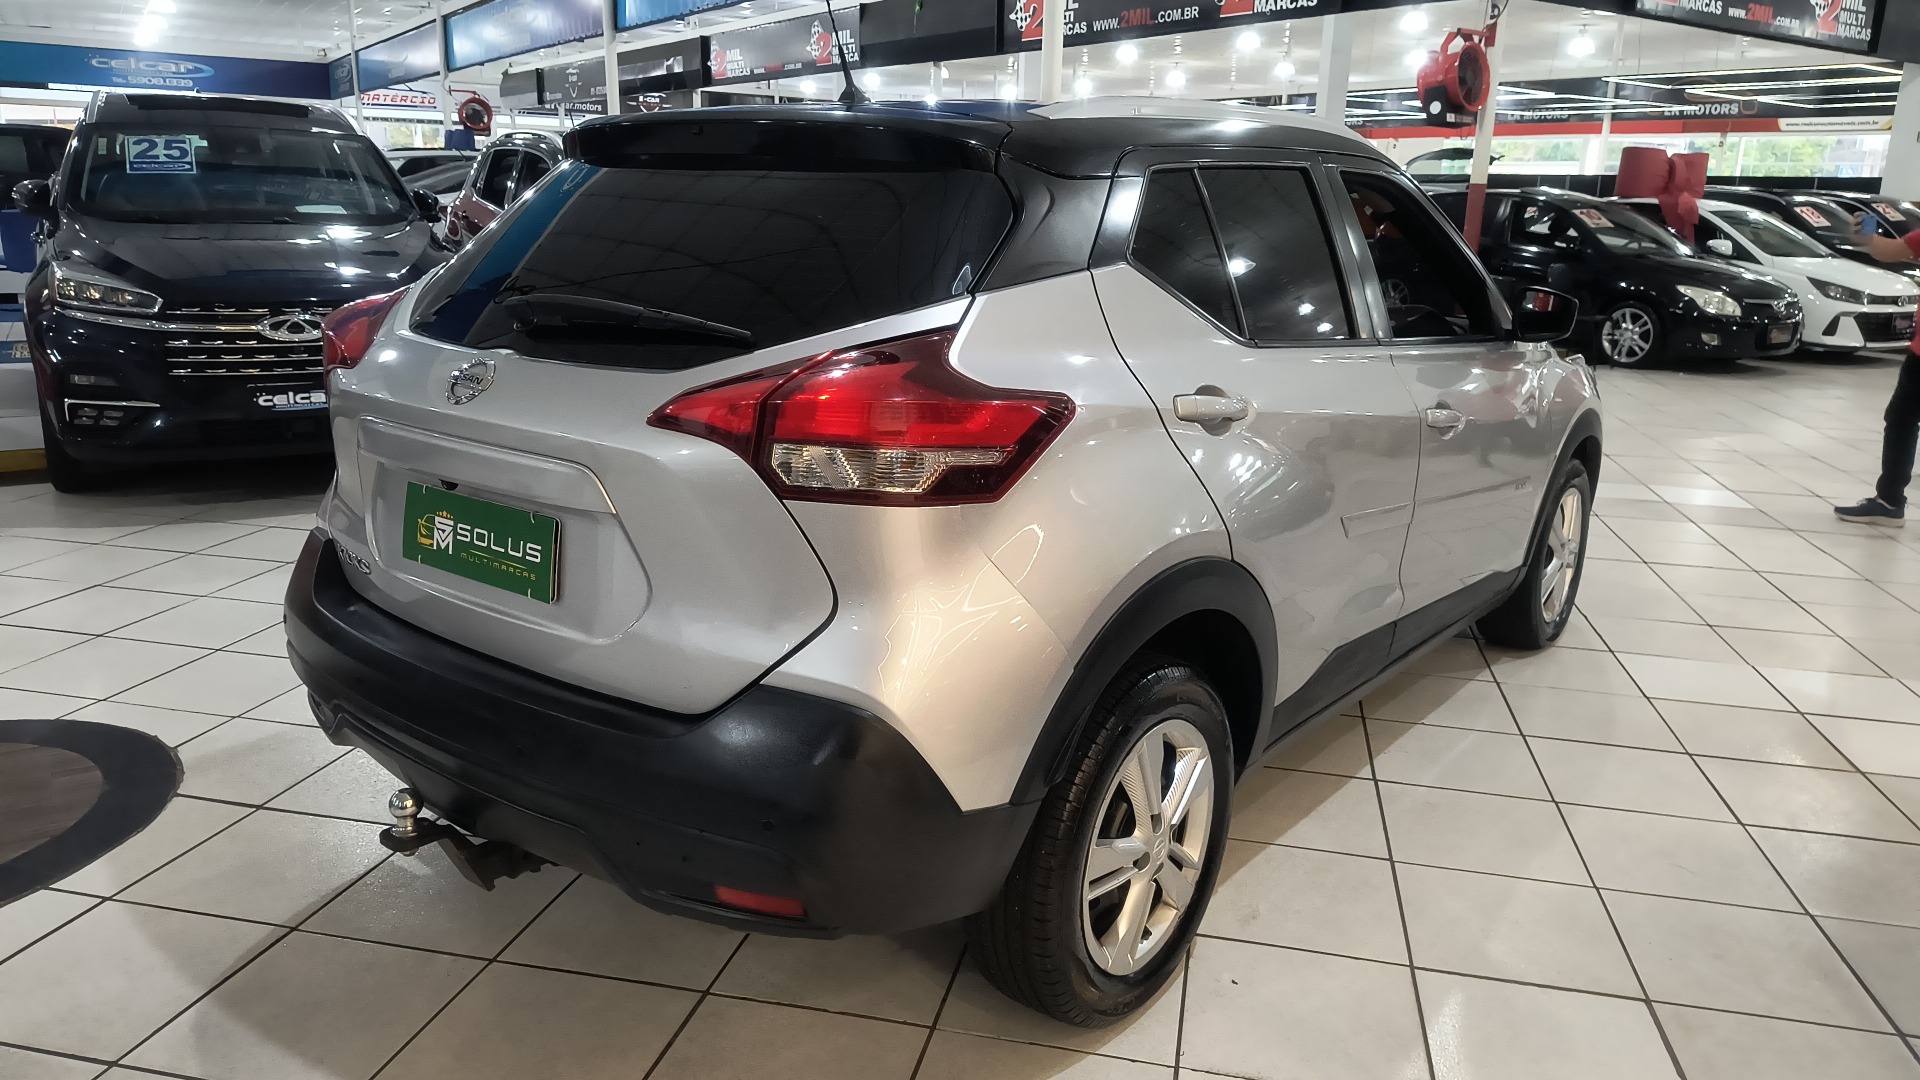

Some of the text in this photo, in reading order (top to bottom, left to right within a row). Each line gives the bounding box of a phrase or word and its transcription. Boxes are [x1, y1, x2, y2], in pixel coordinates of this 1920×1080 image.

[1839, 10, 1866, 26] MULTI
[1837, 23, 1872, 41] MARCAS
[727, 49, 743, 61] MIL
[832, 44, 856, 56] MLTI
[90, 57, 195, 73] celcar
[132, 138, 190, 161] 25
[258, 391, 327, 407] celca
[456, 523, 542, 563] SOLUS
[460, 552, 537, 581] MULTIMARCAS
